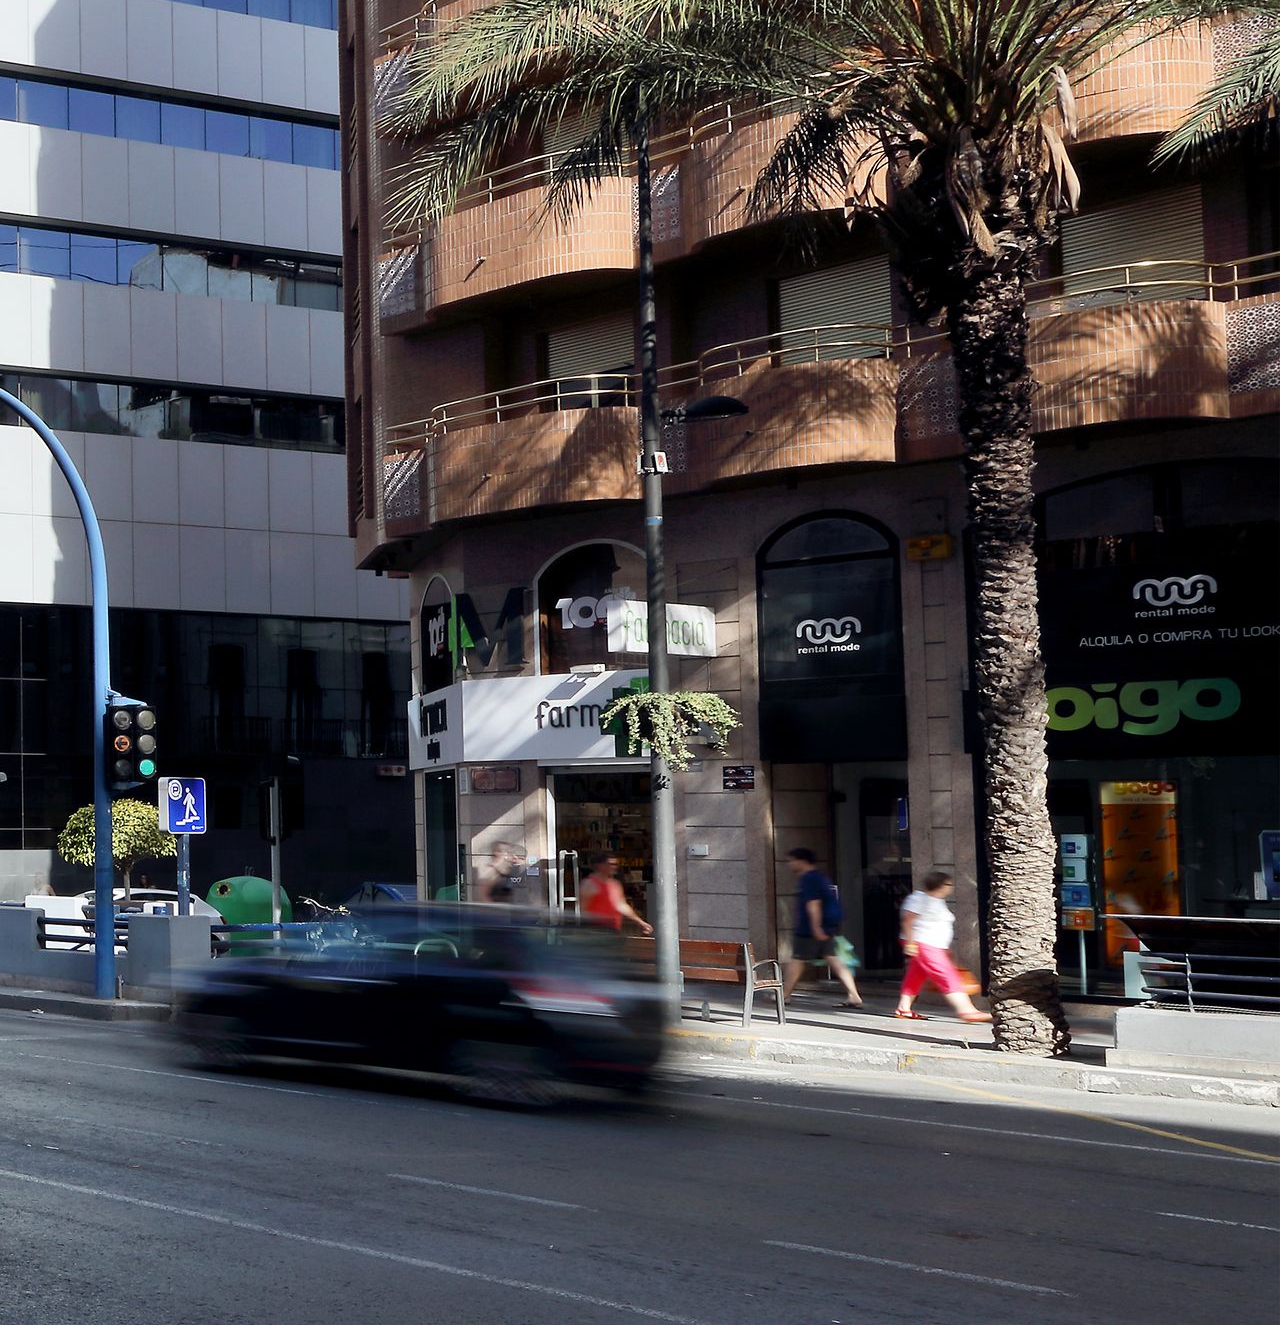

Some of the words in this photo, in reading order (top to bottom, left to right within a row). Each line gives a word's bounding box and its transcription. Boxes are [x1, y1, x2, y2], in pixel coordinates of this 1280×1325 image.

[1134, 607, 1174, 618] rental
[1177, 604, 1216, 615] mode
[624, 610, 706, 647] faacia
[1079, 633, 1134, 647] ALQUILA
[1138, 633, 1149, 644] O
[1153, 629, 1213, 643] COMPRA
[1218, 627, 1238, 639] TU
[1243, 624, 1280, 637] LOOK
[797, 644, 828, 655] rental
[830, 642, 861, 652] mode
[1045, 677, 1241, 736] oigo
